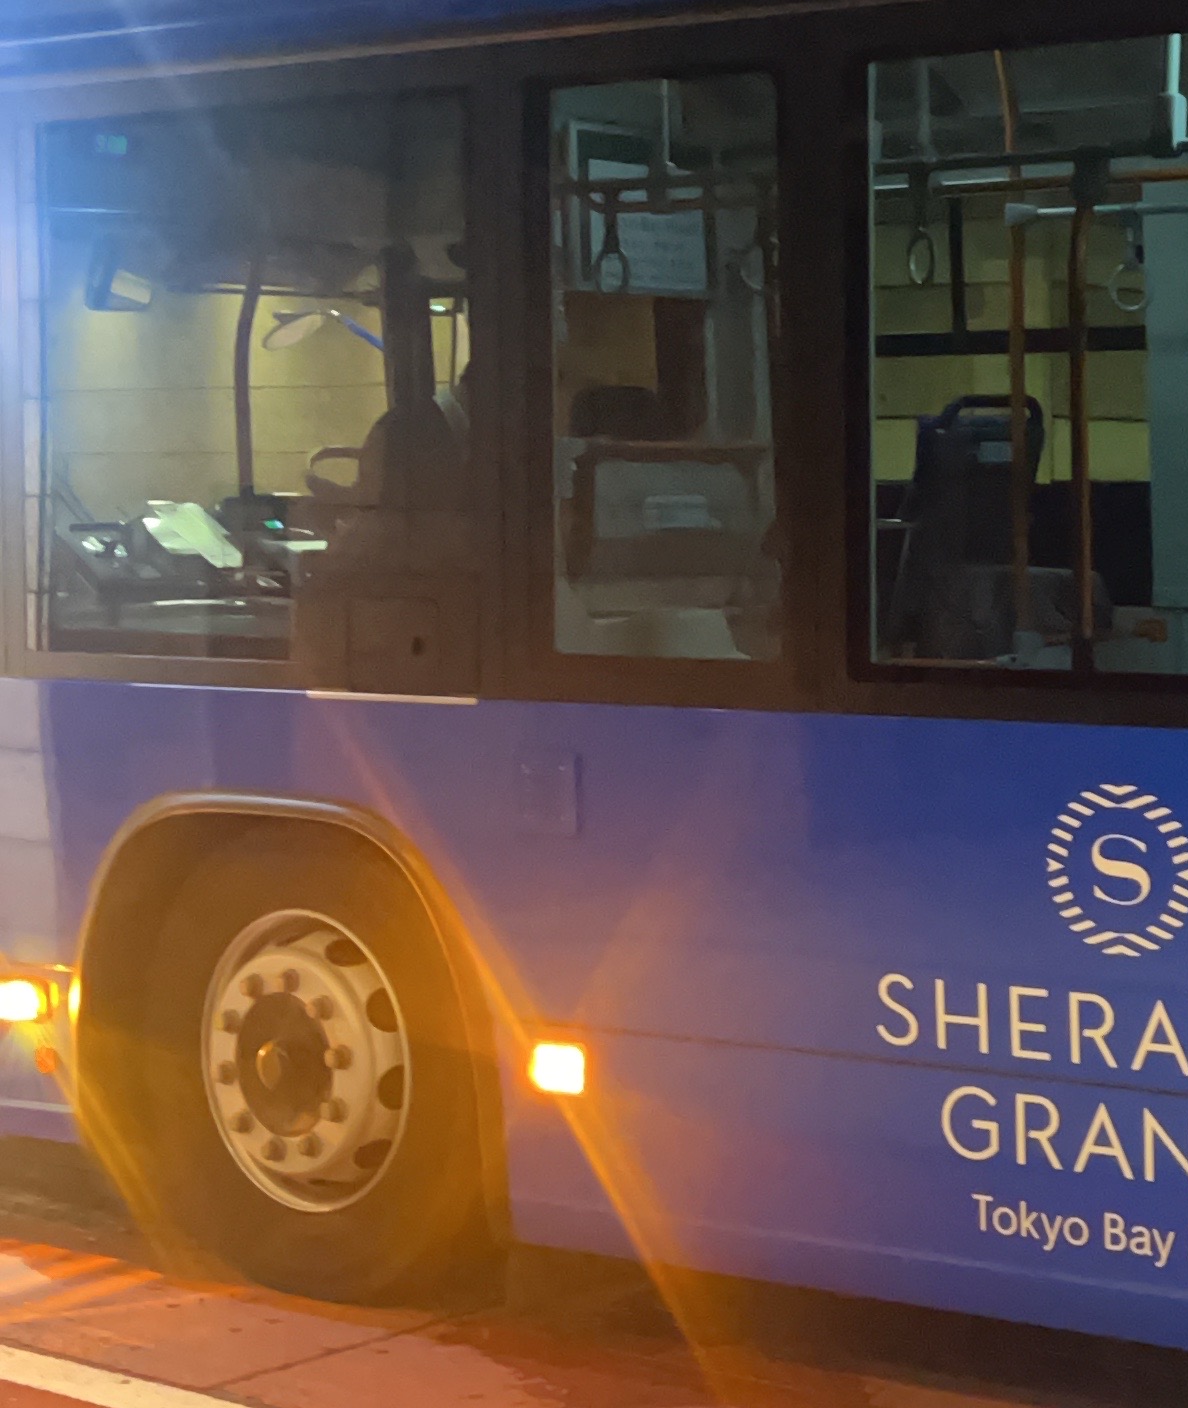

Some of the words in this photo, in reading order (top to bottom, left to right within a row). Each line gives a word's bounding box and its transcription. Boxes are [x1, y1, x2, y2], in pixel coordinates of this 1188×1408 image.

[1090, 834, 1152, 906] S
[971, 1192, 1090, 1251] Tokyo
[1103, 1212, 1176, 1268] Bay
